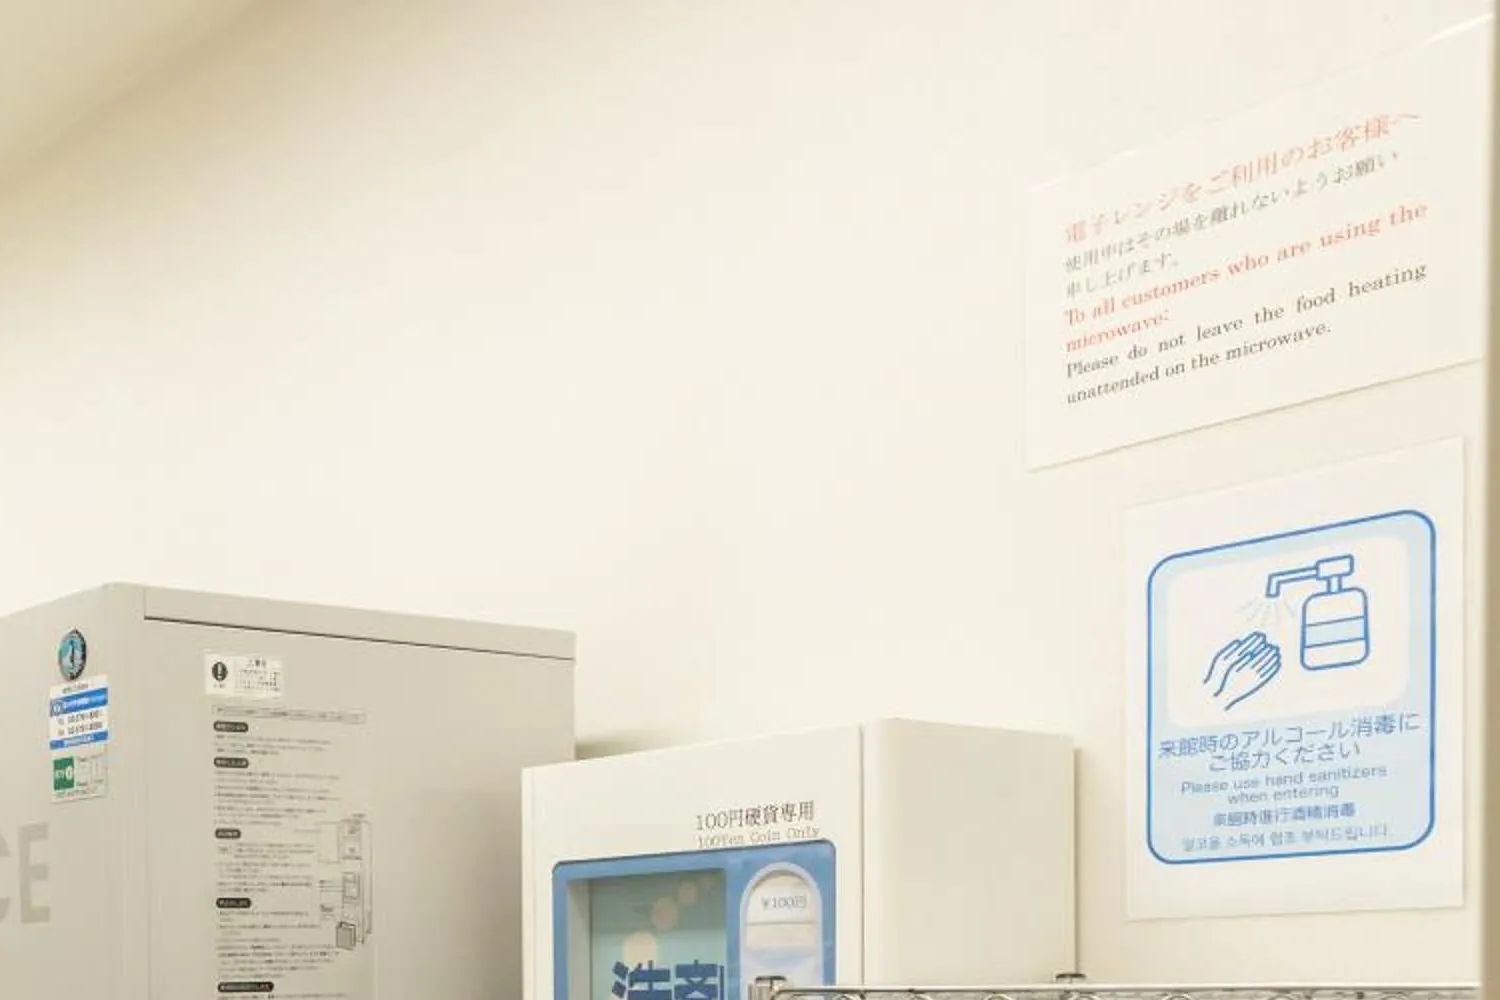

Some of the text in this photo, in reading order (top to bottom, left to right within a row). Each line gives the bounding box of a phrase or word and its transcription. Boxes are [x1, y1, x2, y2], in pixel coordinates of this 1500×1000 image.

[1065, 112, 1420, 243] 電子レンジをご利用のお客様へ
[1065, 204, 1428, 326] To all customers who are using the
[1067, 264, 1427, 379] Please do not leave the food heating
[1067, 322, 1332, 405] unattended on the microwave.
[1158, 713, 1421, 758] 来館時のアルコール消毒に
[1209, 741, 1361, 773] ご協力ください
[1181, 765, 1388, 796] Please use hand sanitizers
[1228, 785, 1340, 805] when entering
[696, 800, 814, 831] 100円硬貨専用
